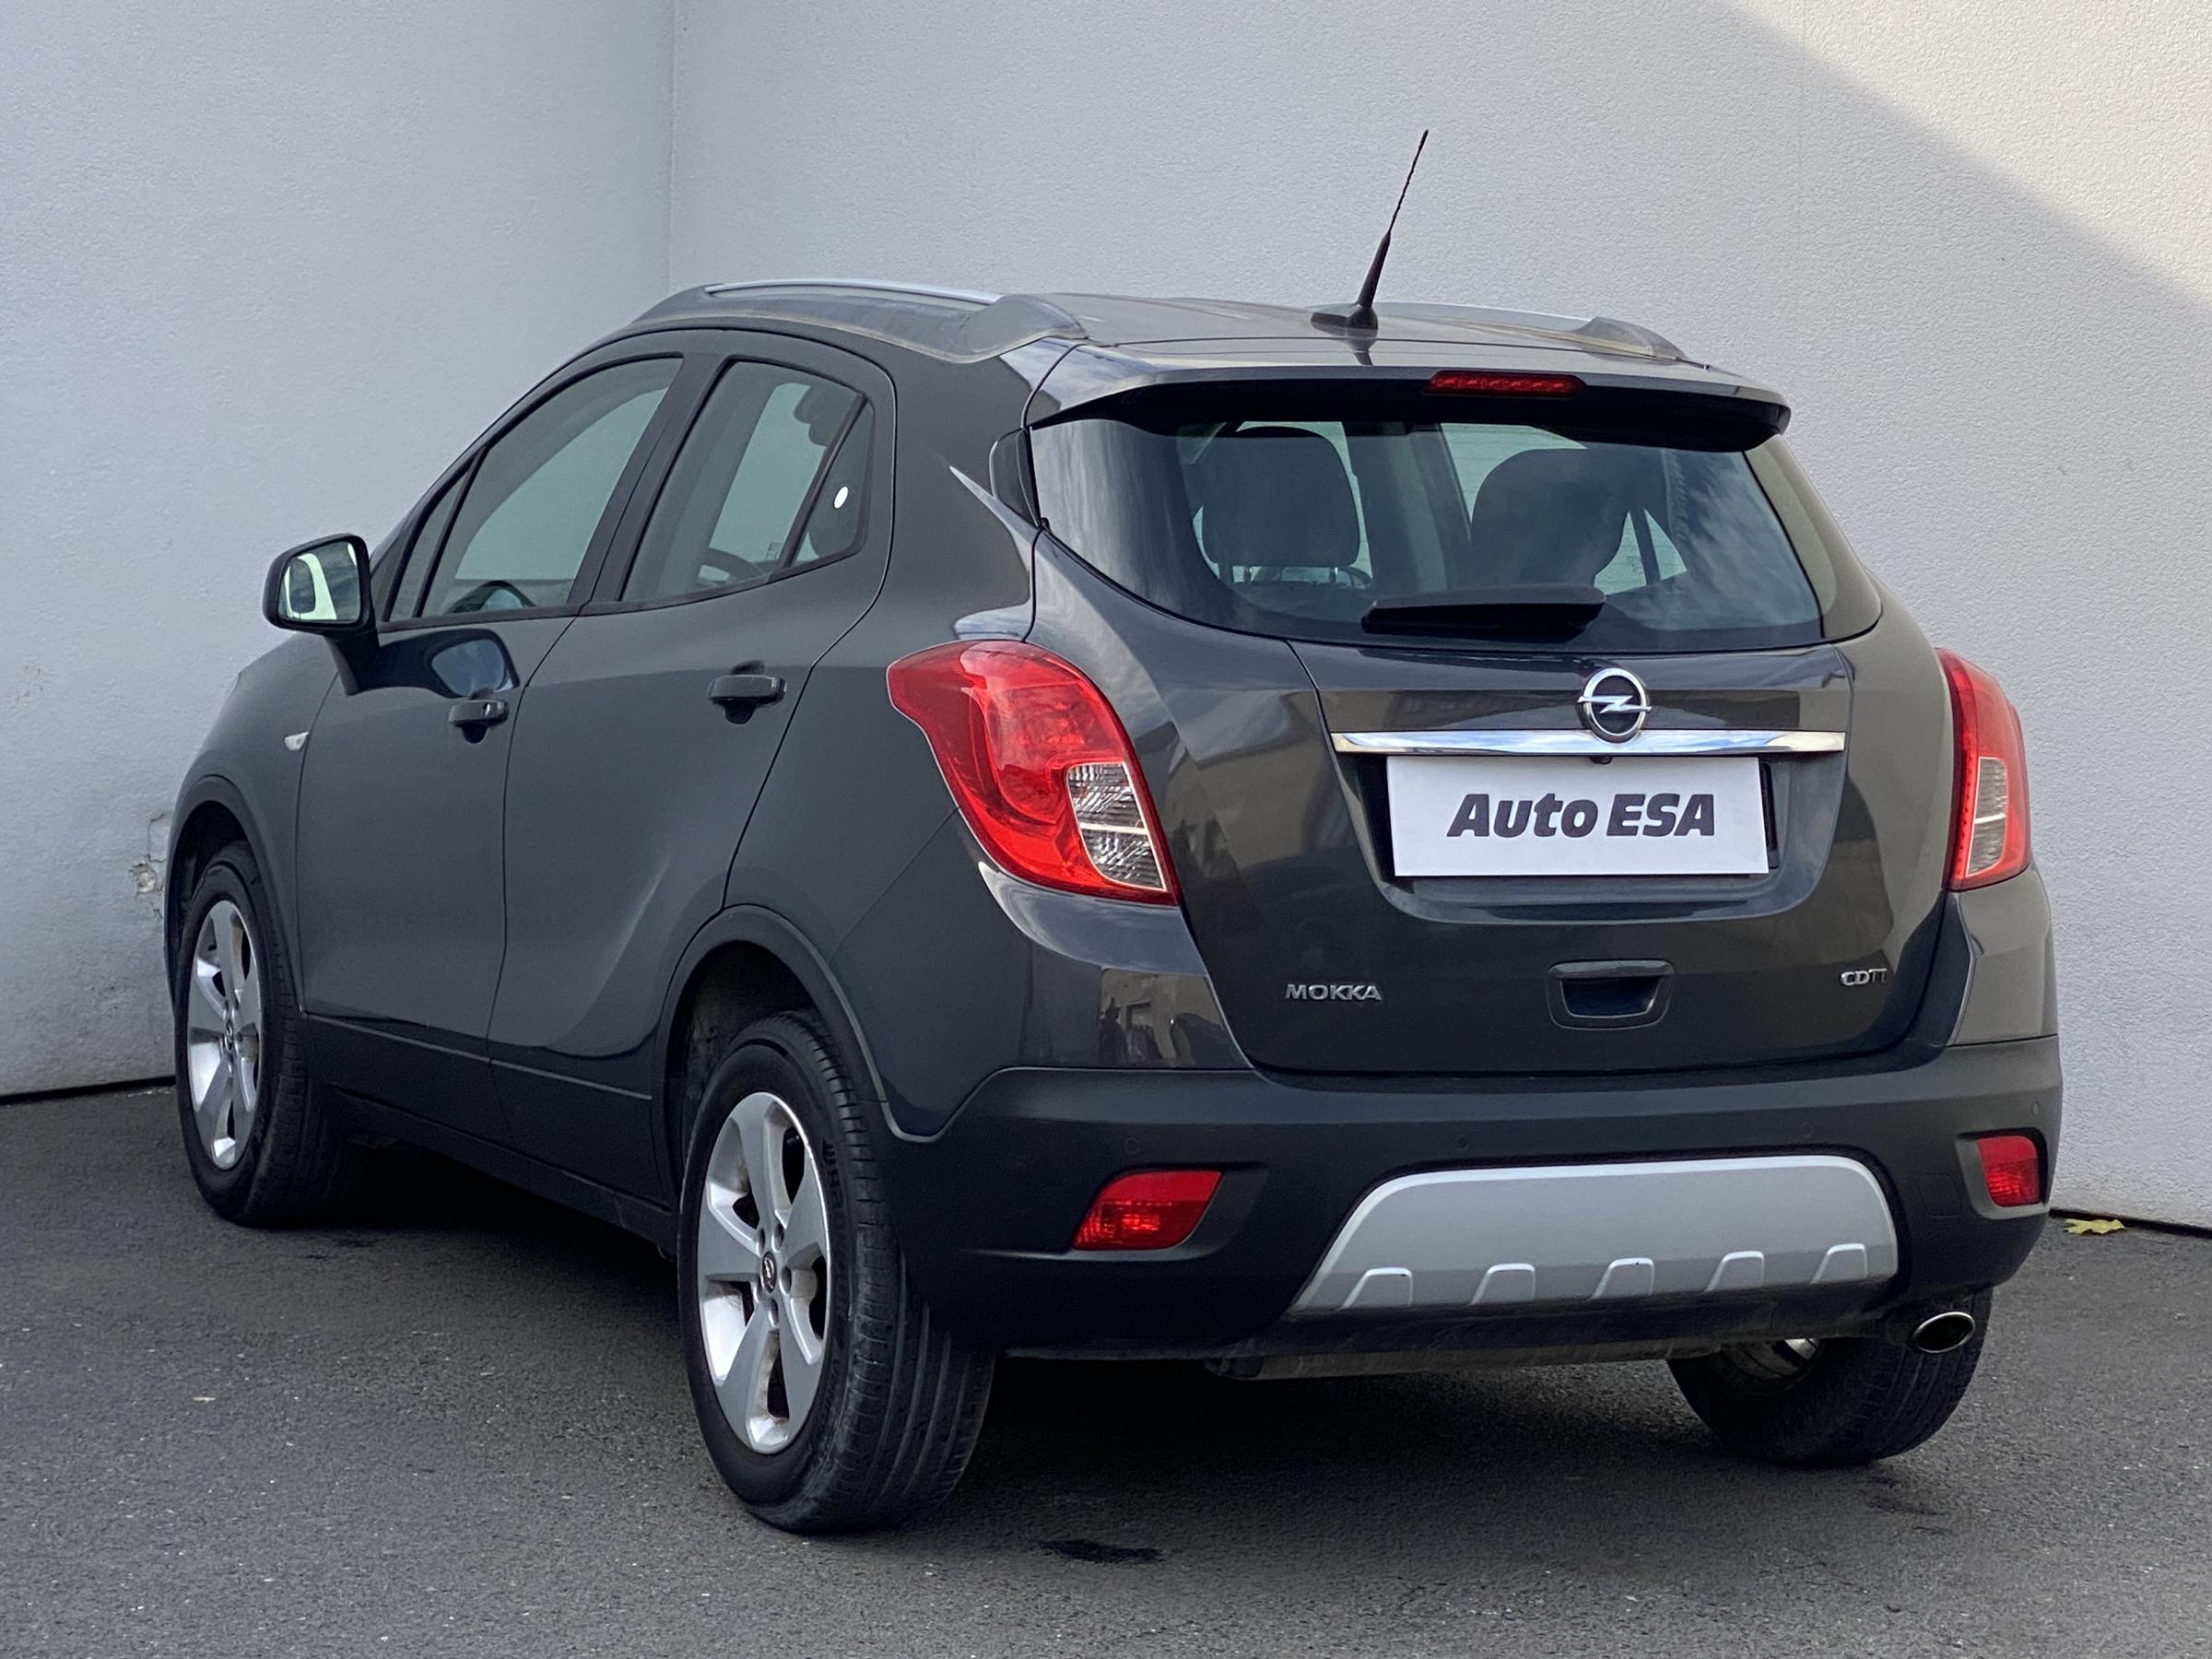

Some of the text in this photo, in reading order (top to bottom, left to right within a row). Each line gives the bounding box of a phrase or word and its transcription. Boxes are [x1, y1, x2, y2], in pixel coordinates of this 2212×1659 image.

[1446, 793, 1714, 838] Auto ESA
[1285, 983, 1382, 1001] MOKKA
